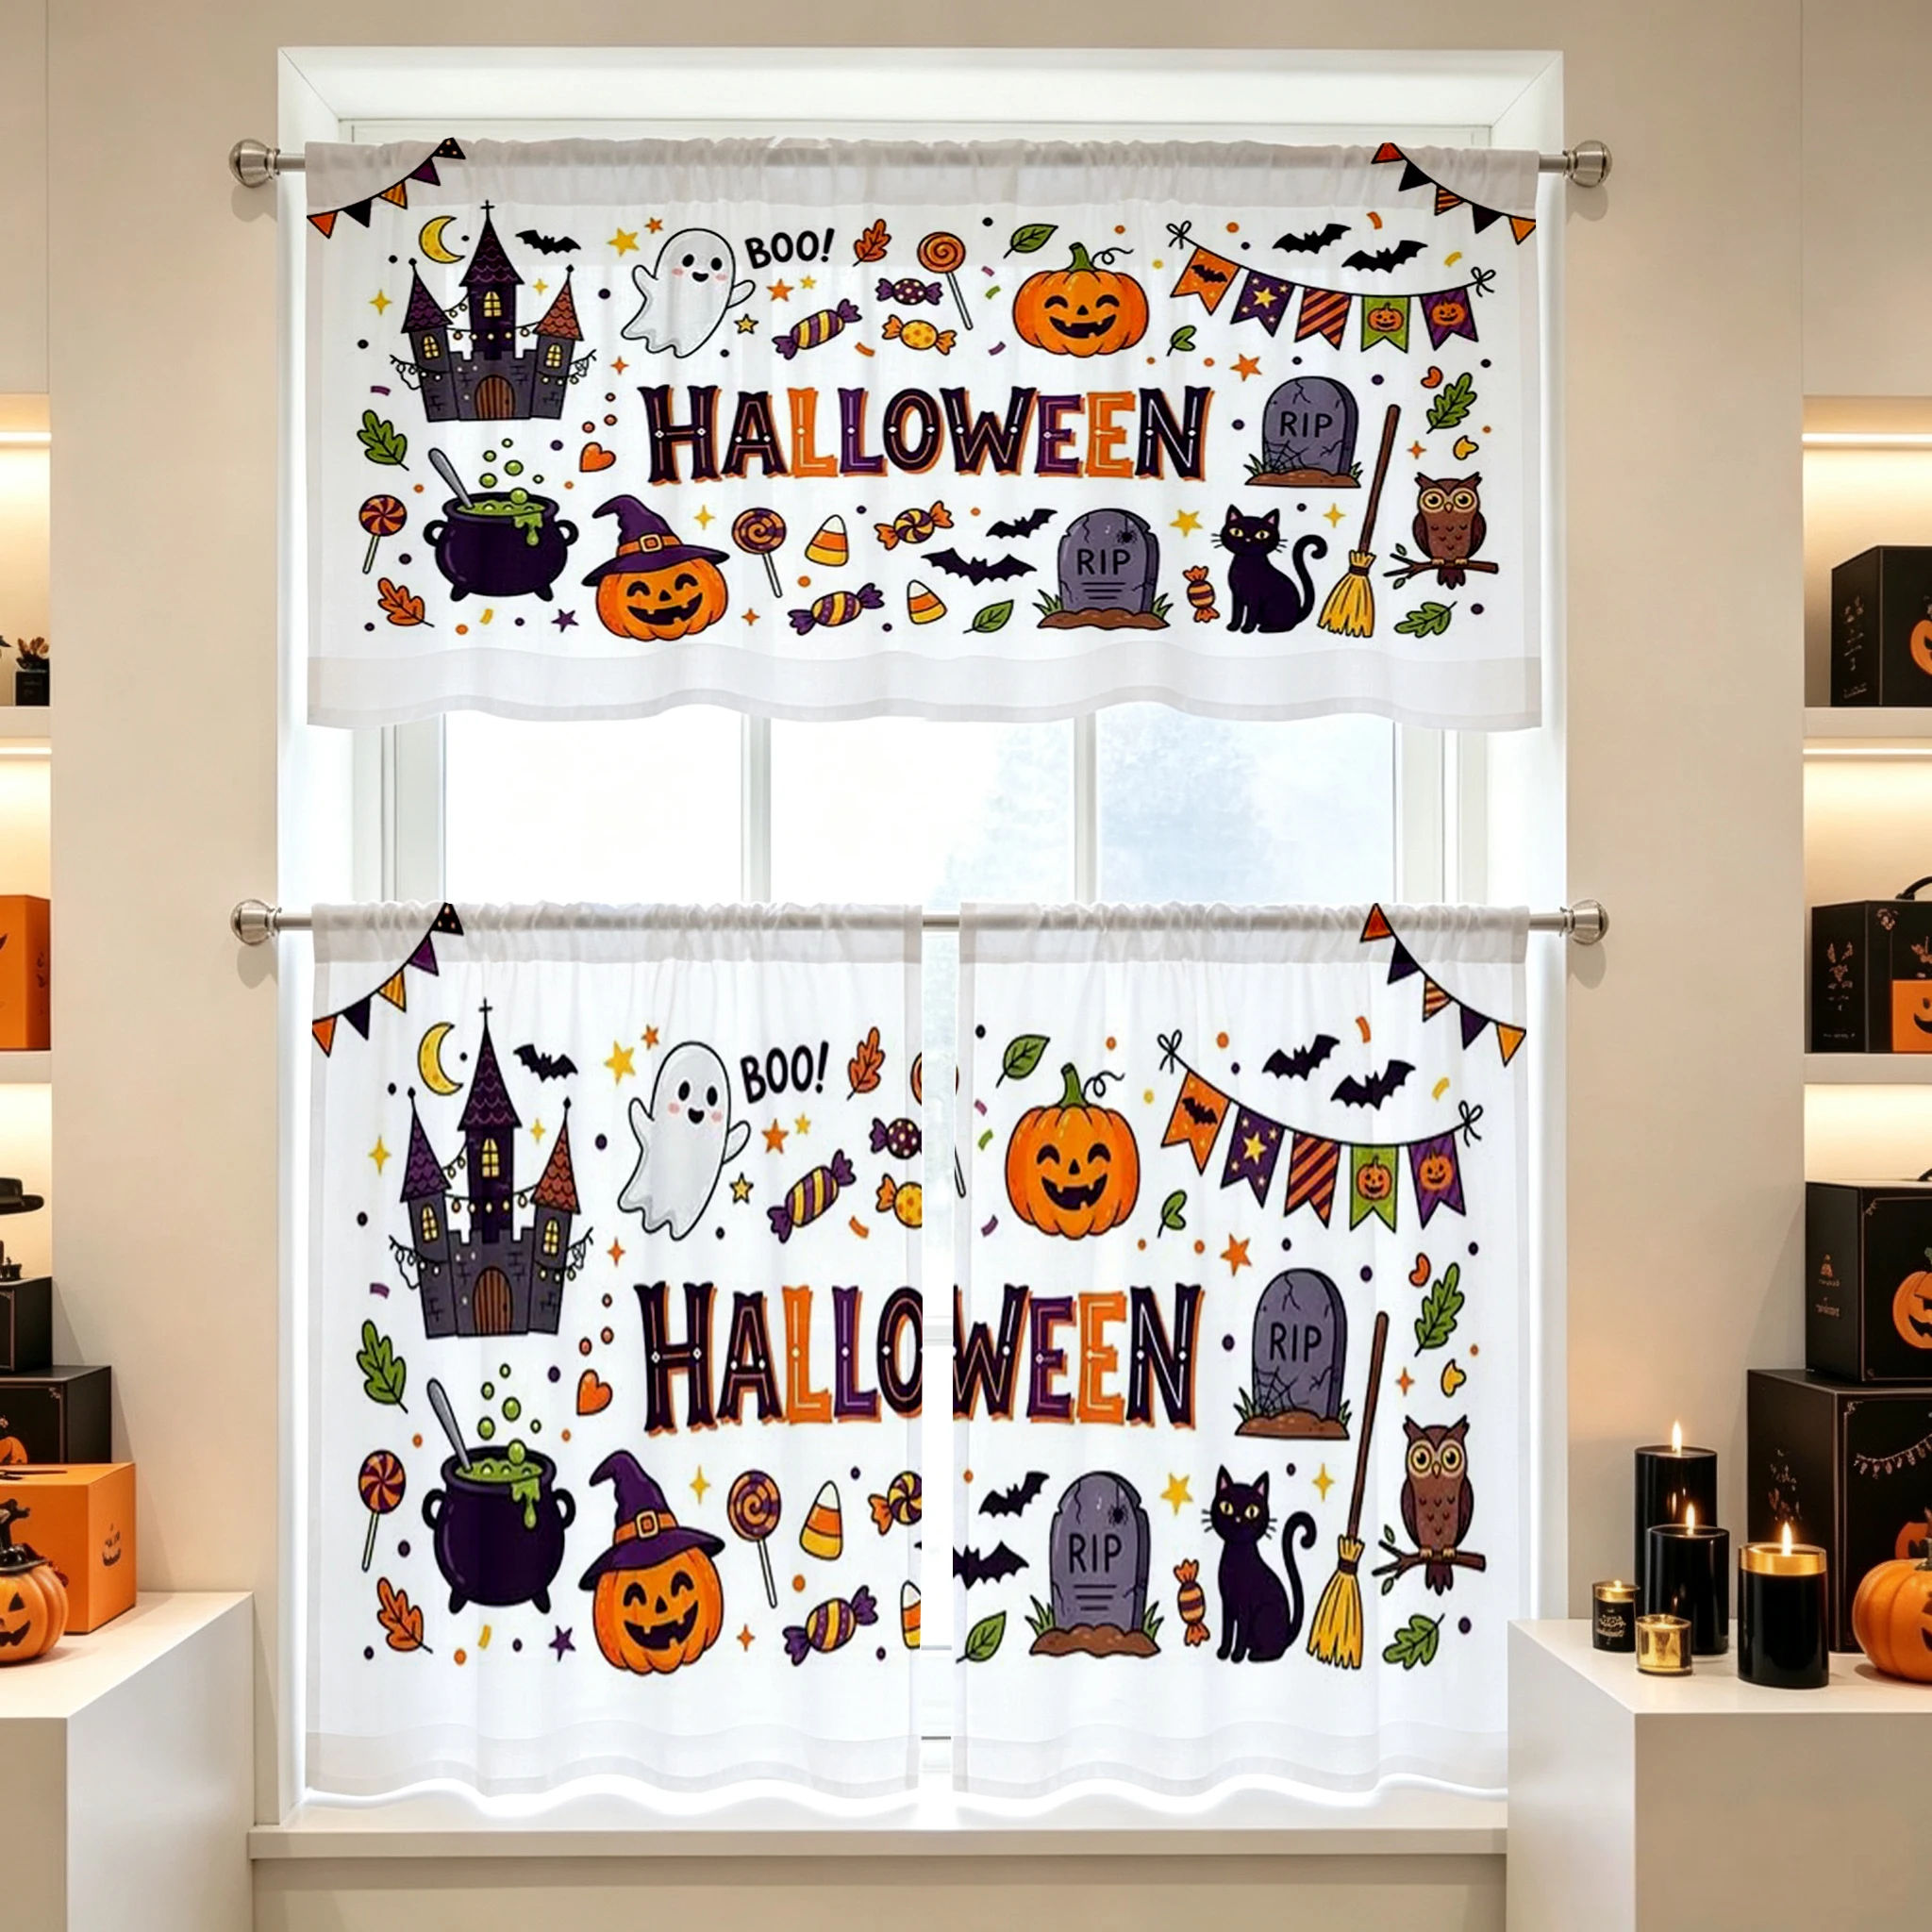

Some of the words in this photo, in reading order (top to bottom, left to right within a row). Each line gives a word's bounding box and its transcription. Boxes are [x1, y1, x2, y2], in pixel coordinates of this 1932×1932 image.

[744, 227, 835, 269] BOO!
[637, 383, 1215, 486] HALLOWEEN
[1279, 410, 1333, 438] RIP
[1076, 548, 1131, 575] RIP
[740, 1040, 829, 1105] BOO!
[1270, 1322, 1322, 1362] RIP
[1068, 1532, 1123, 1574] RIP
